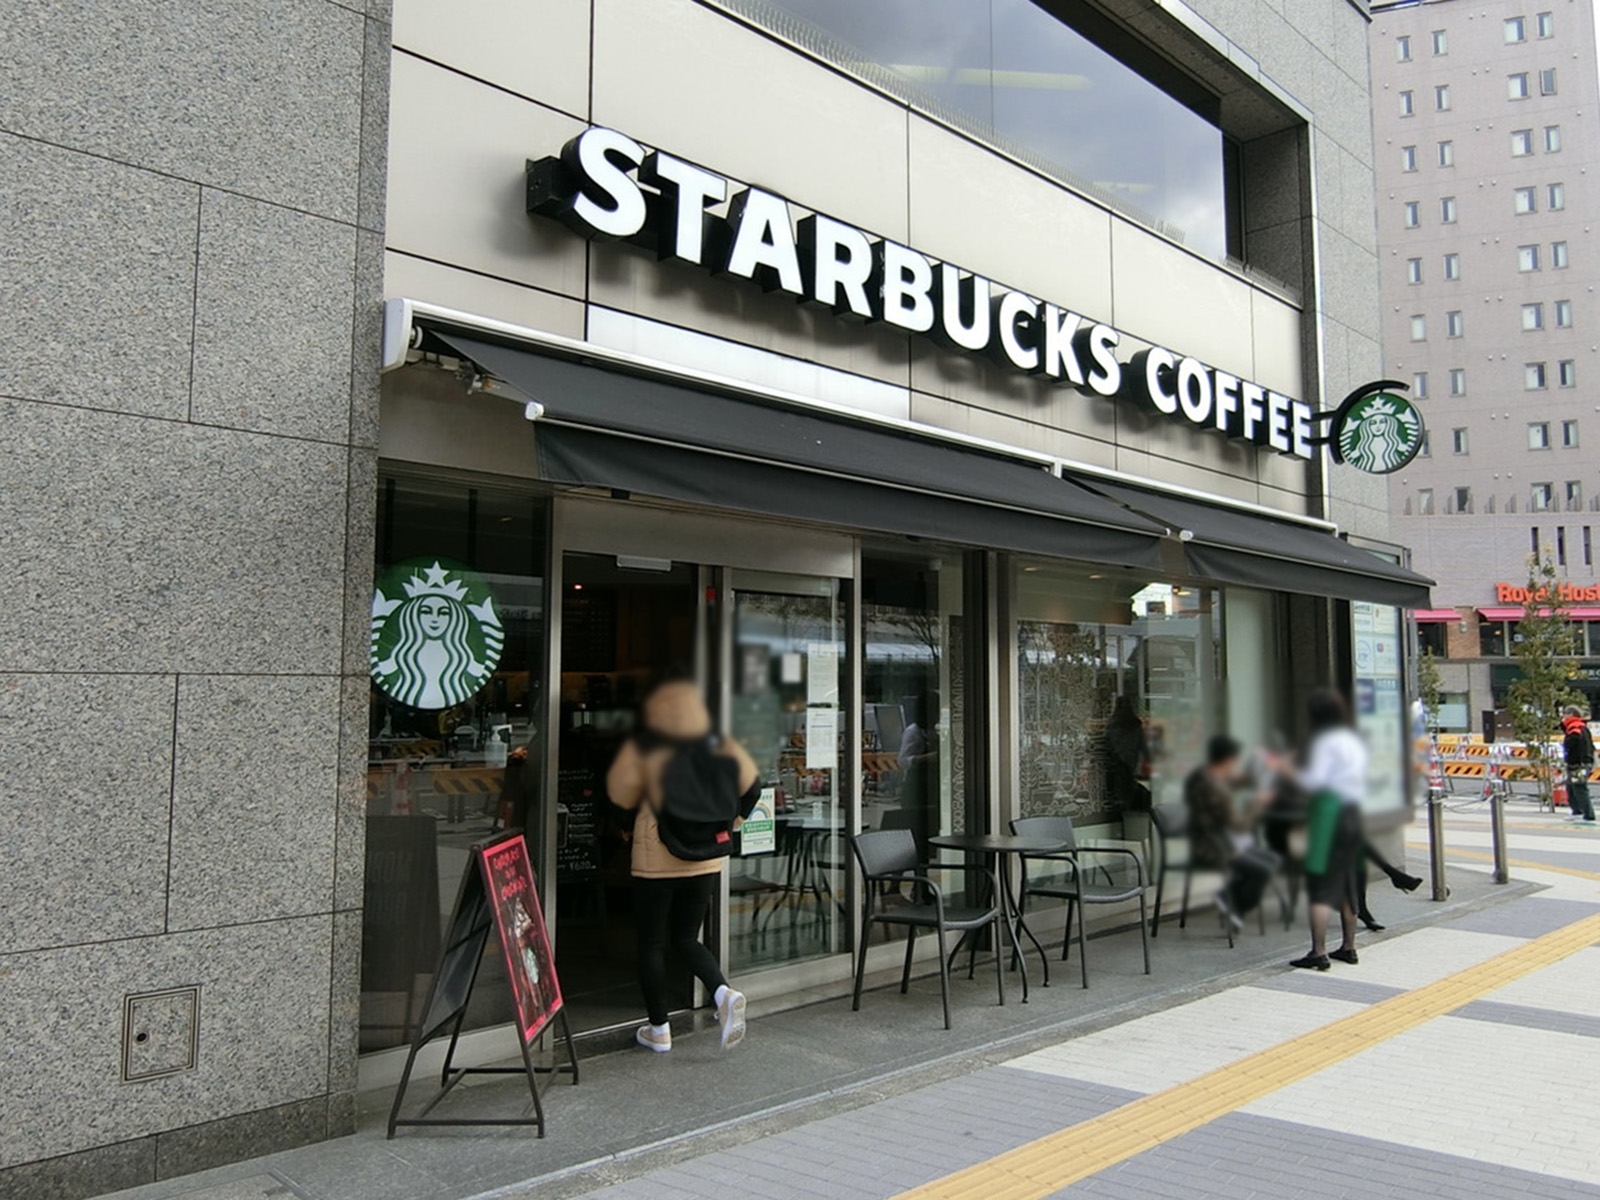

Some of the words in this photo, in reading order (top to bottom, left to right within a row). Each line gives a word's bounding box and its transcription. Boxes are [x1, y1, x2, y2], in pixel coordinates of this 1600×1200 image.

[573, 127, 1121, 397] STARBUCKS
[1146, 347, 1313, 459] COFFEE
[1496, 582, 1551, 605] Roya
